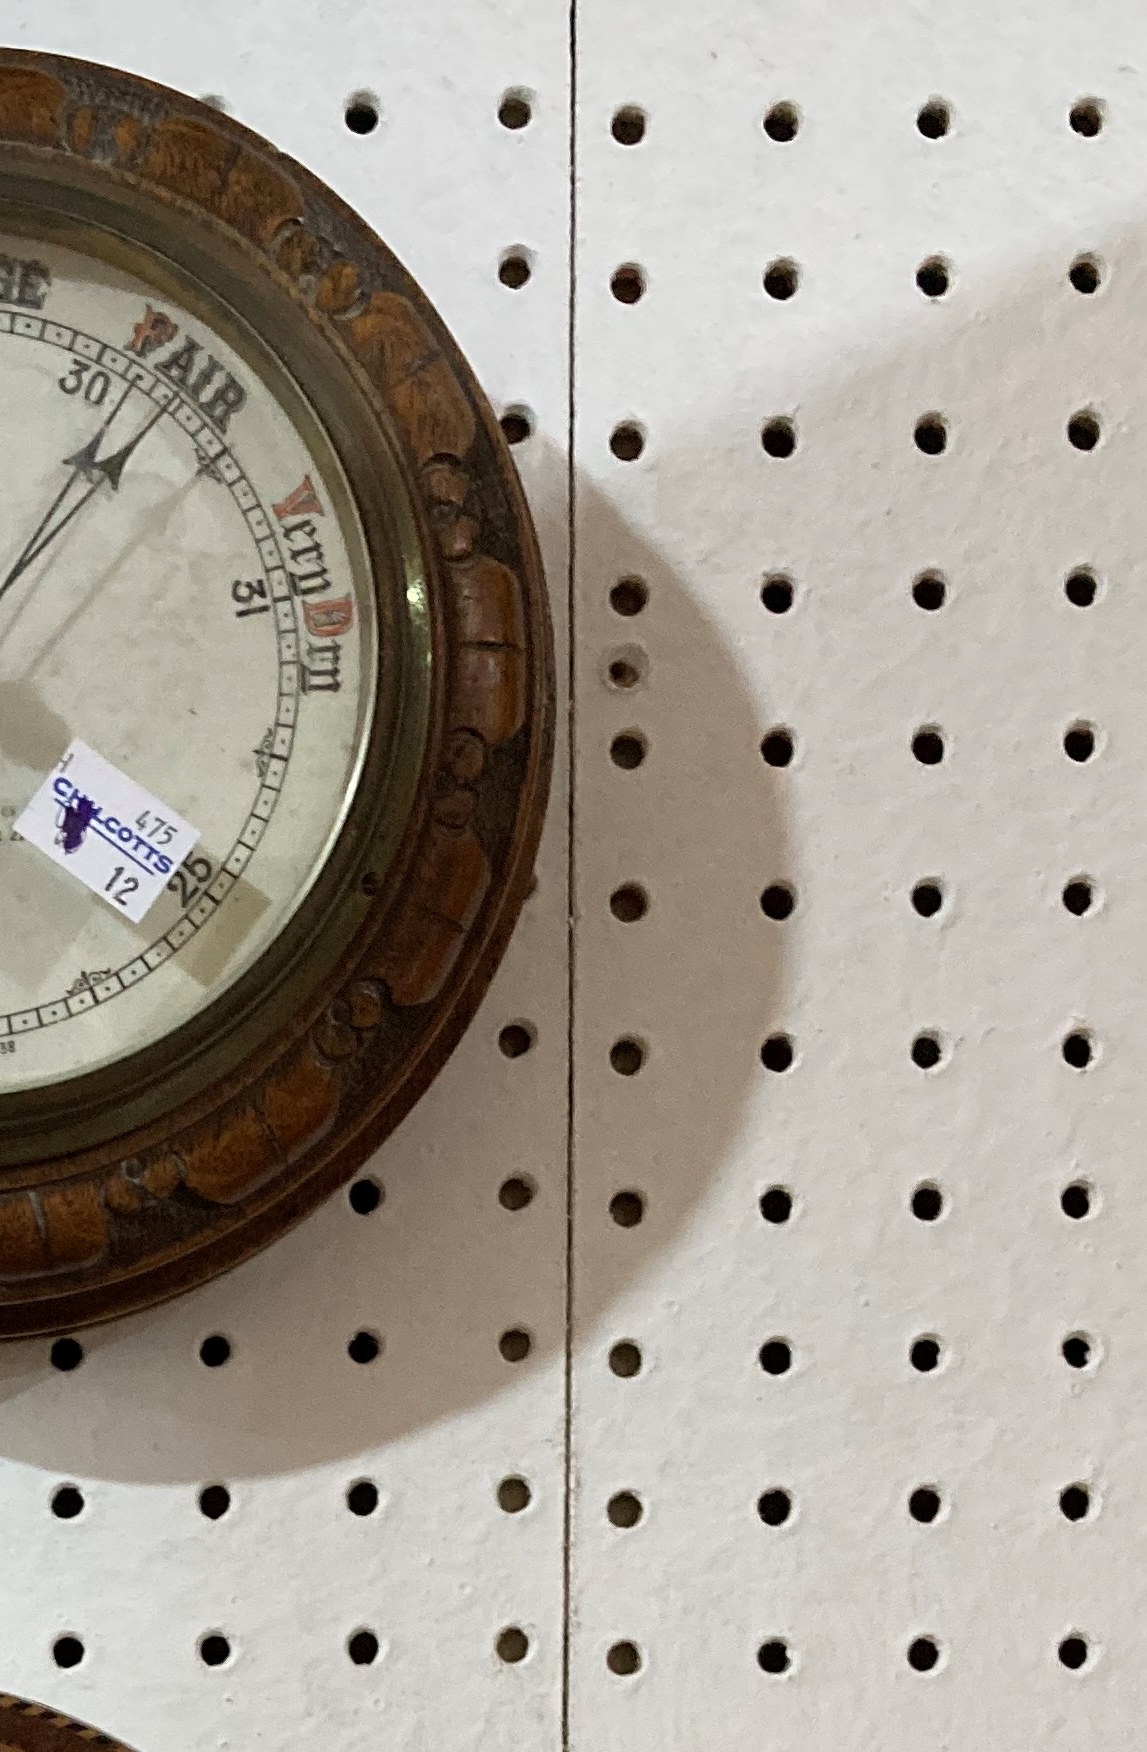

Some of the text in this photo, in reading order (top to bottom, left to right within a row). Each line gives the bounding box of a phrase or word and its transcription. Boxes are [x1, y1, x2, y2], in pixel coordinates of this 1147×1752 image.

[58, 358, 111, 405] 30
[124, 304, 248, 434] FAIR
[231, 578, 270, 618] 31
[134, 809, 179, 846] 475
[104, 865, 141, 907] 12
[168, 851, 212, 909] 25
